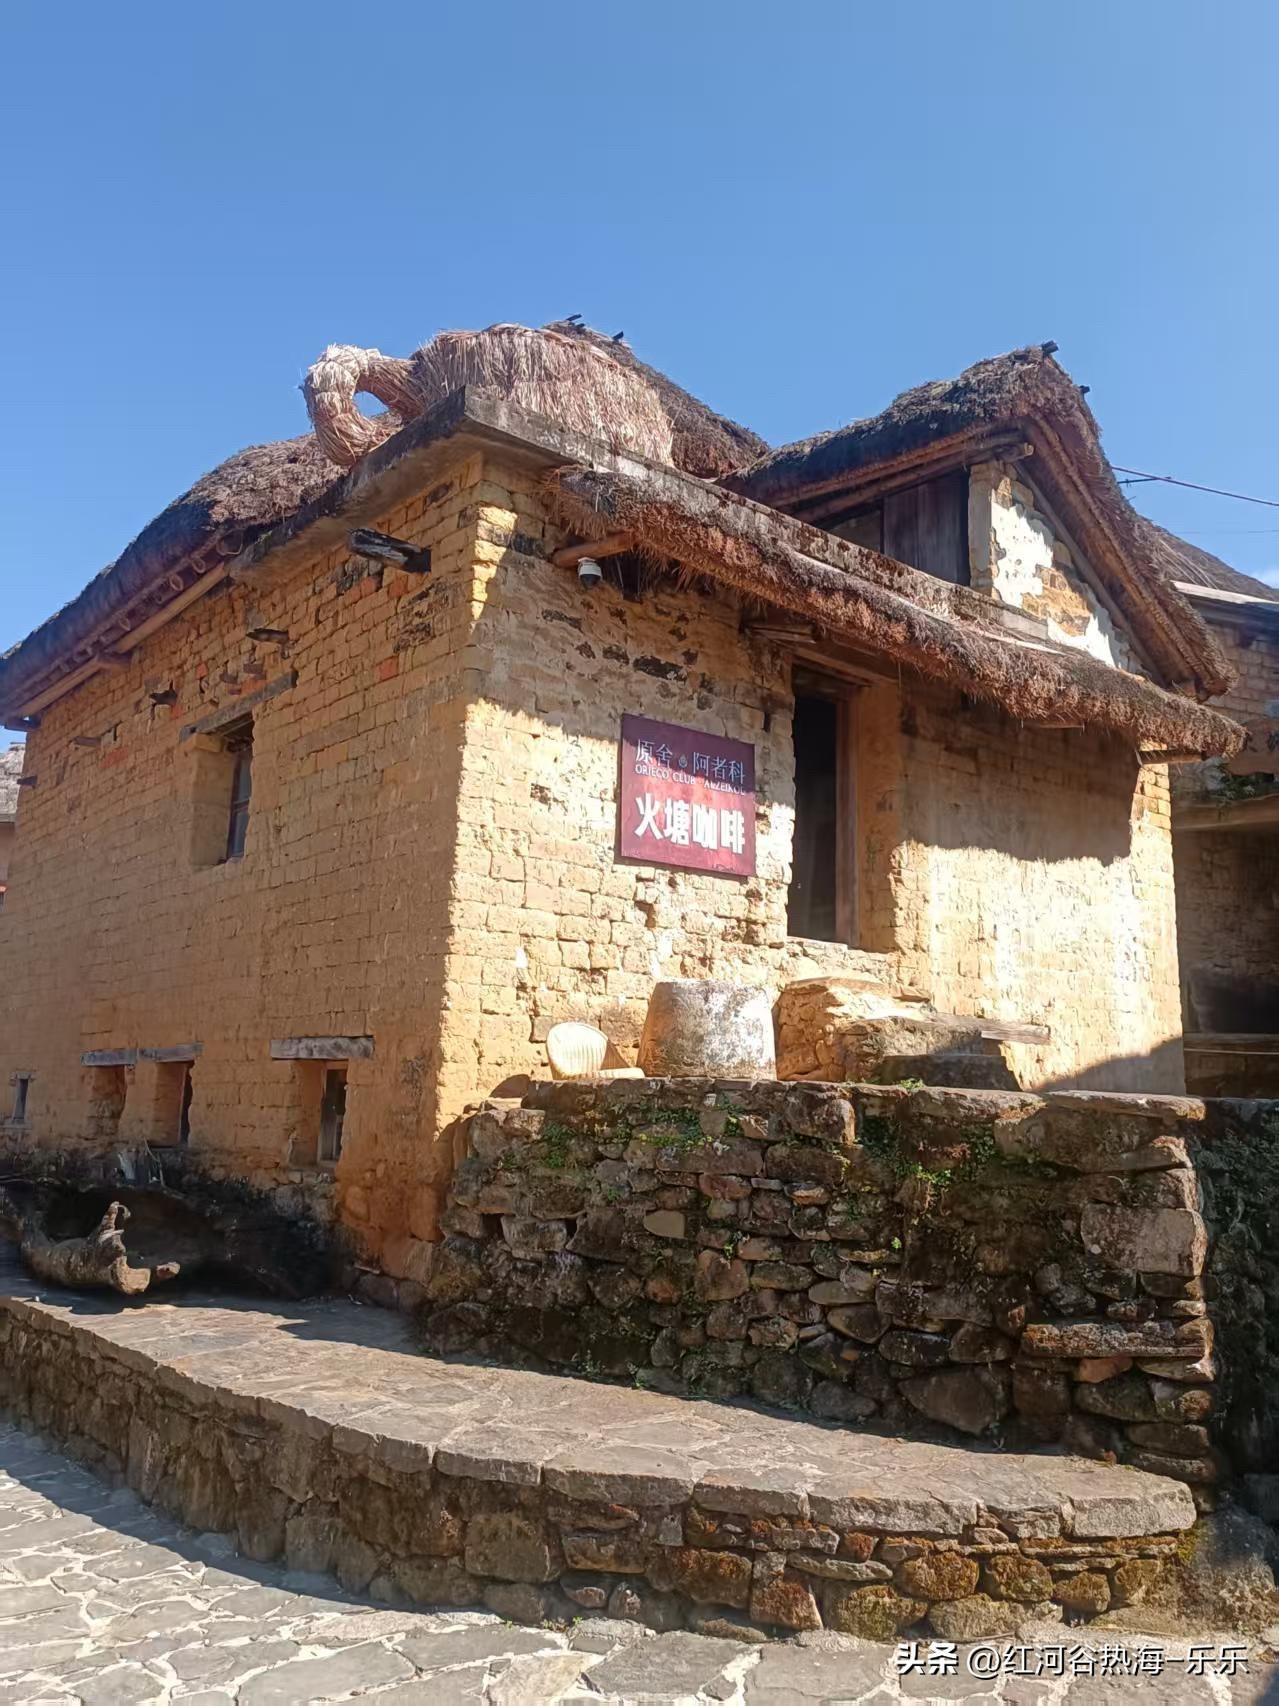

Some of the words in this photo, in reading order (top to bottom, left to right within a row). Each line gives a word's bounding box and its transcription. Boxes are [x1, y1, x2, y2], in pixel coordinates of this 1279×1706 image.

[635, 739, 673, 769] 原舍
[693, 752, 745, 784] 阿者科
[672, 772, 696, 784] CLUB
[634, 792, 745, 854] 火塘咖啡
